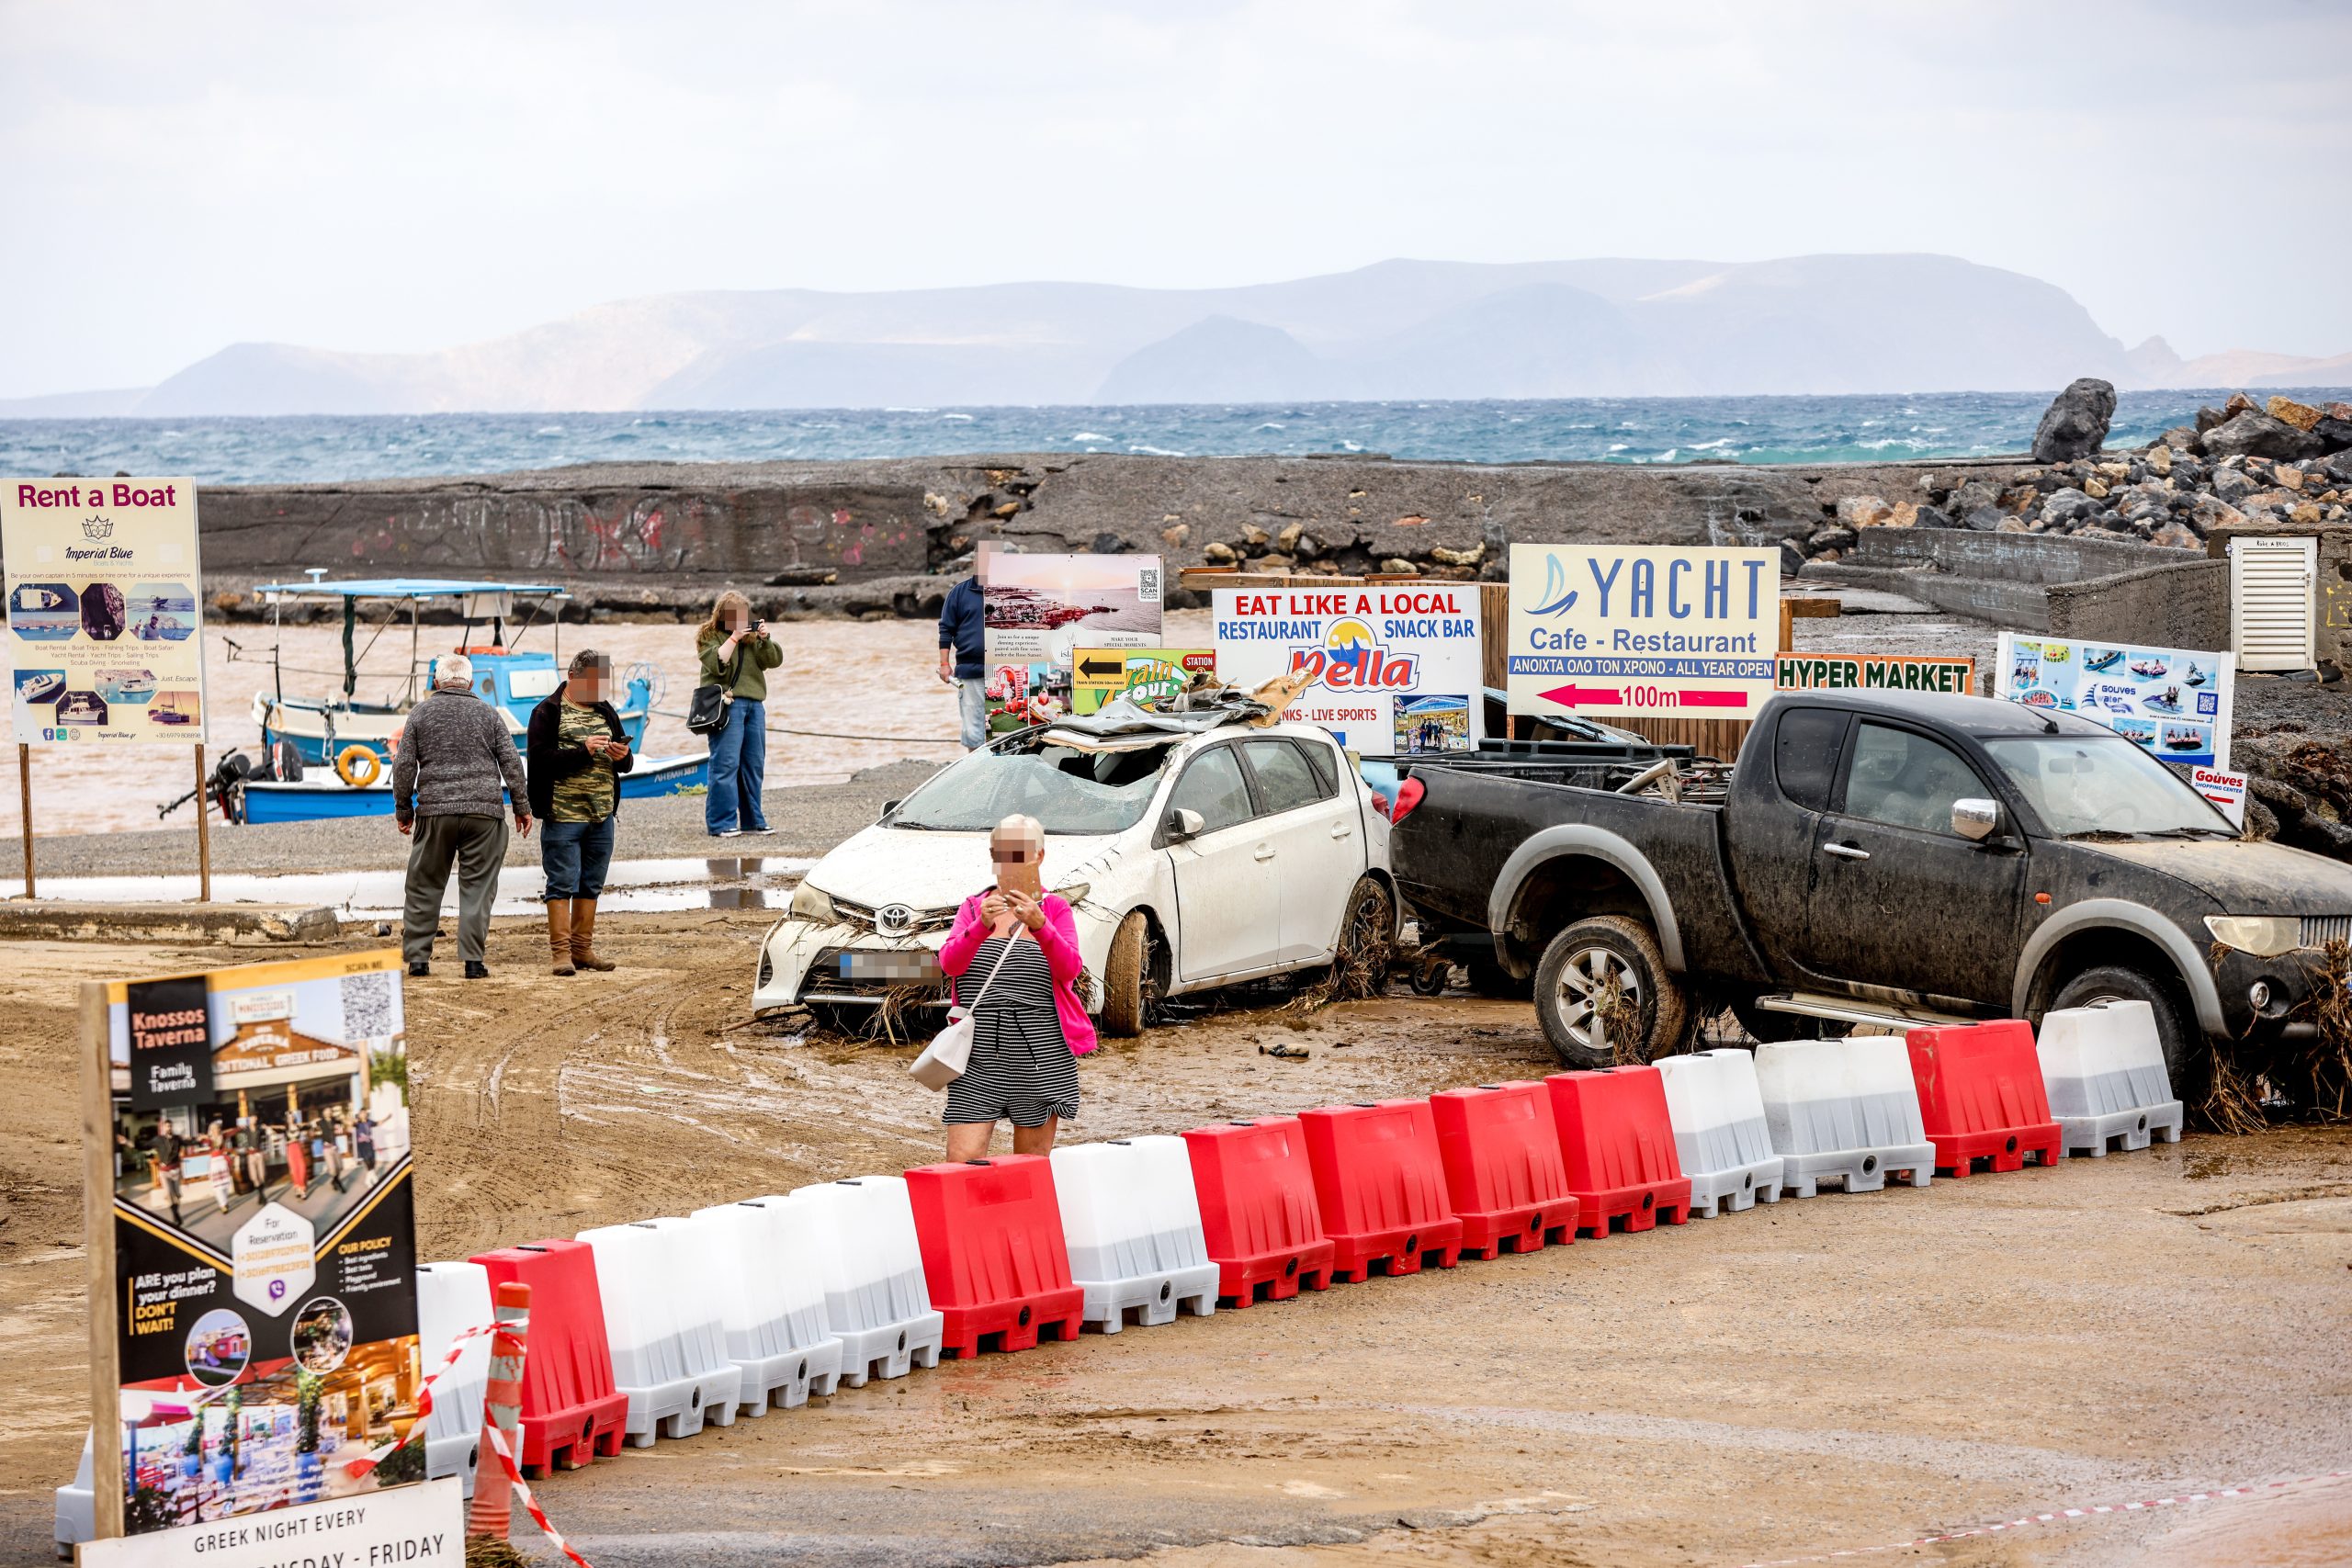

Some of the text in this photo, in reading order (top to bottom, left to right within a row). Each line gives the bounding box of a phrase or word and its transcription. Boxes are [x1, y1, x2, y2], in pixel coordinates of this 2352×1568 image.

[18, 483, 175, 507] Rent a Boat
[65, 546, 133, 562] Imperial Blue
[1588, 558, 1766, 619] YACHT
[1236, 593, 1461, 615] EAT LIKE A LOCAL
[1218, 618, 1476, 640] RESTAURANT SNACK BAR
[1530, 627, 1587, 650] Cafe
[1612, 628, 1757, 653] Restaurant
[1186, 657, 1213, 666] STATION
[1513, 658, 1564, 673] ΑΝΟΙΧΤΑ
[1567, 659, 1592, 673] ΟΛΟ
[1596, 660, 1620, 674] ΤΟΝ
[1623, 660, 1666, 675] ΧΡΟΝΟ
[1676, 660, 1699, 675] ALL
[1702, 661, 1735, 676] YEAR
[1737, 661, 1772, 676] OPEN
[1779, 660, 1968, 693] HYPER MARKET
[1623, 685, 1677, 707] 100m
[1311, 708, 1336, 721] LIVE
[1337, 708, 1377, 721] SPORTS
[2195, 770, 2244, 787] Gouves
[2195, 782, 2222, 791] SHOPPING
[132, 1008, 206, 1031] Knossos
[132, 1027, 206, 1050] Taverna
[150, 1062, 193, 1079] Family
[148, 1077, 197, 1093] Taverna
[265, 1219, 280, 1229] For
[249, 1229, 299, 1246] Reservation
[337, 1236, 392, 1255] OUR POLICY
[135, 1273, 162, 1290] ARE
[163, 1272, 186, 1290] you
[187, 1268, 216, 1286] plan
[138, 1281, 217, 1306] your dinner?
[135, 1302, 177, 1319] DON'T
[135, 1317, 175, 1336] WAIT!
[195, 1507, 366, 1552] GREEK NIGHT EVERY
[369, 1533, 444, 1566] FRIDAY
